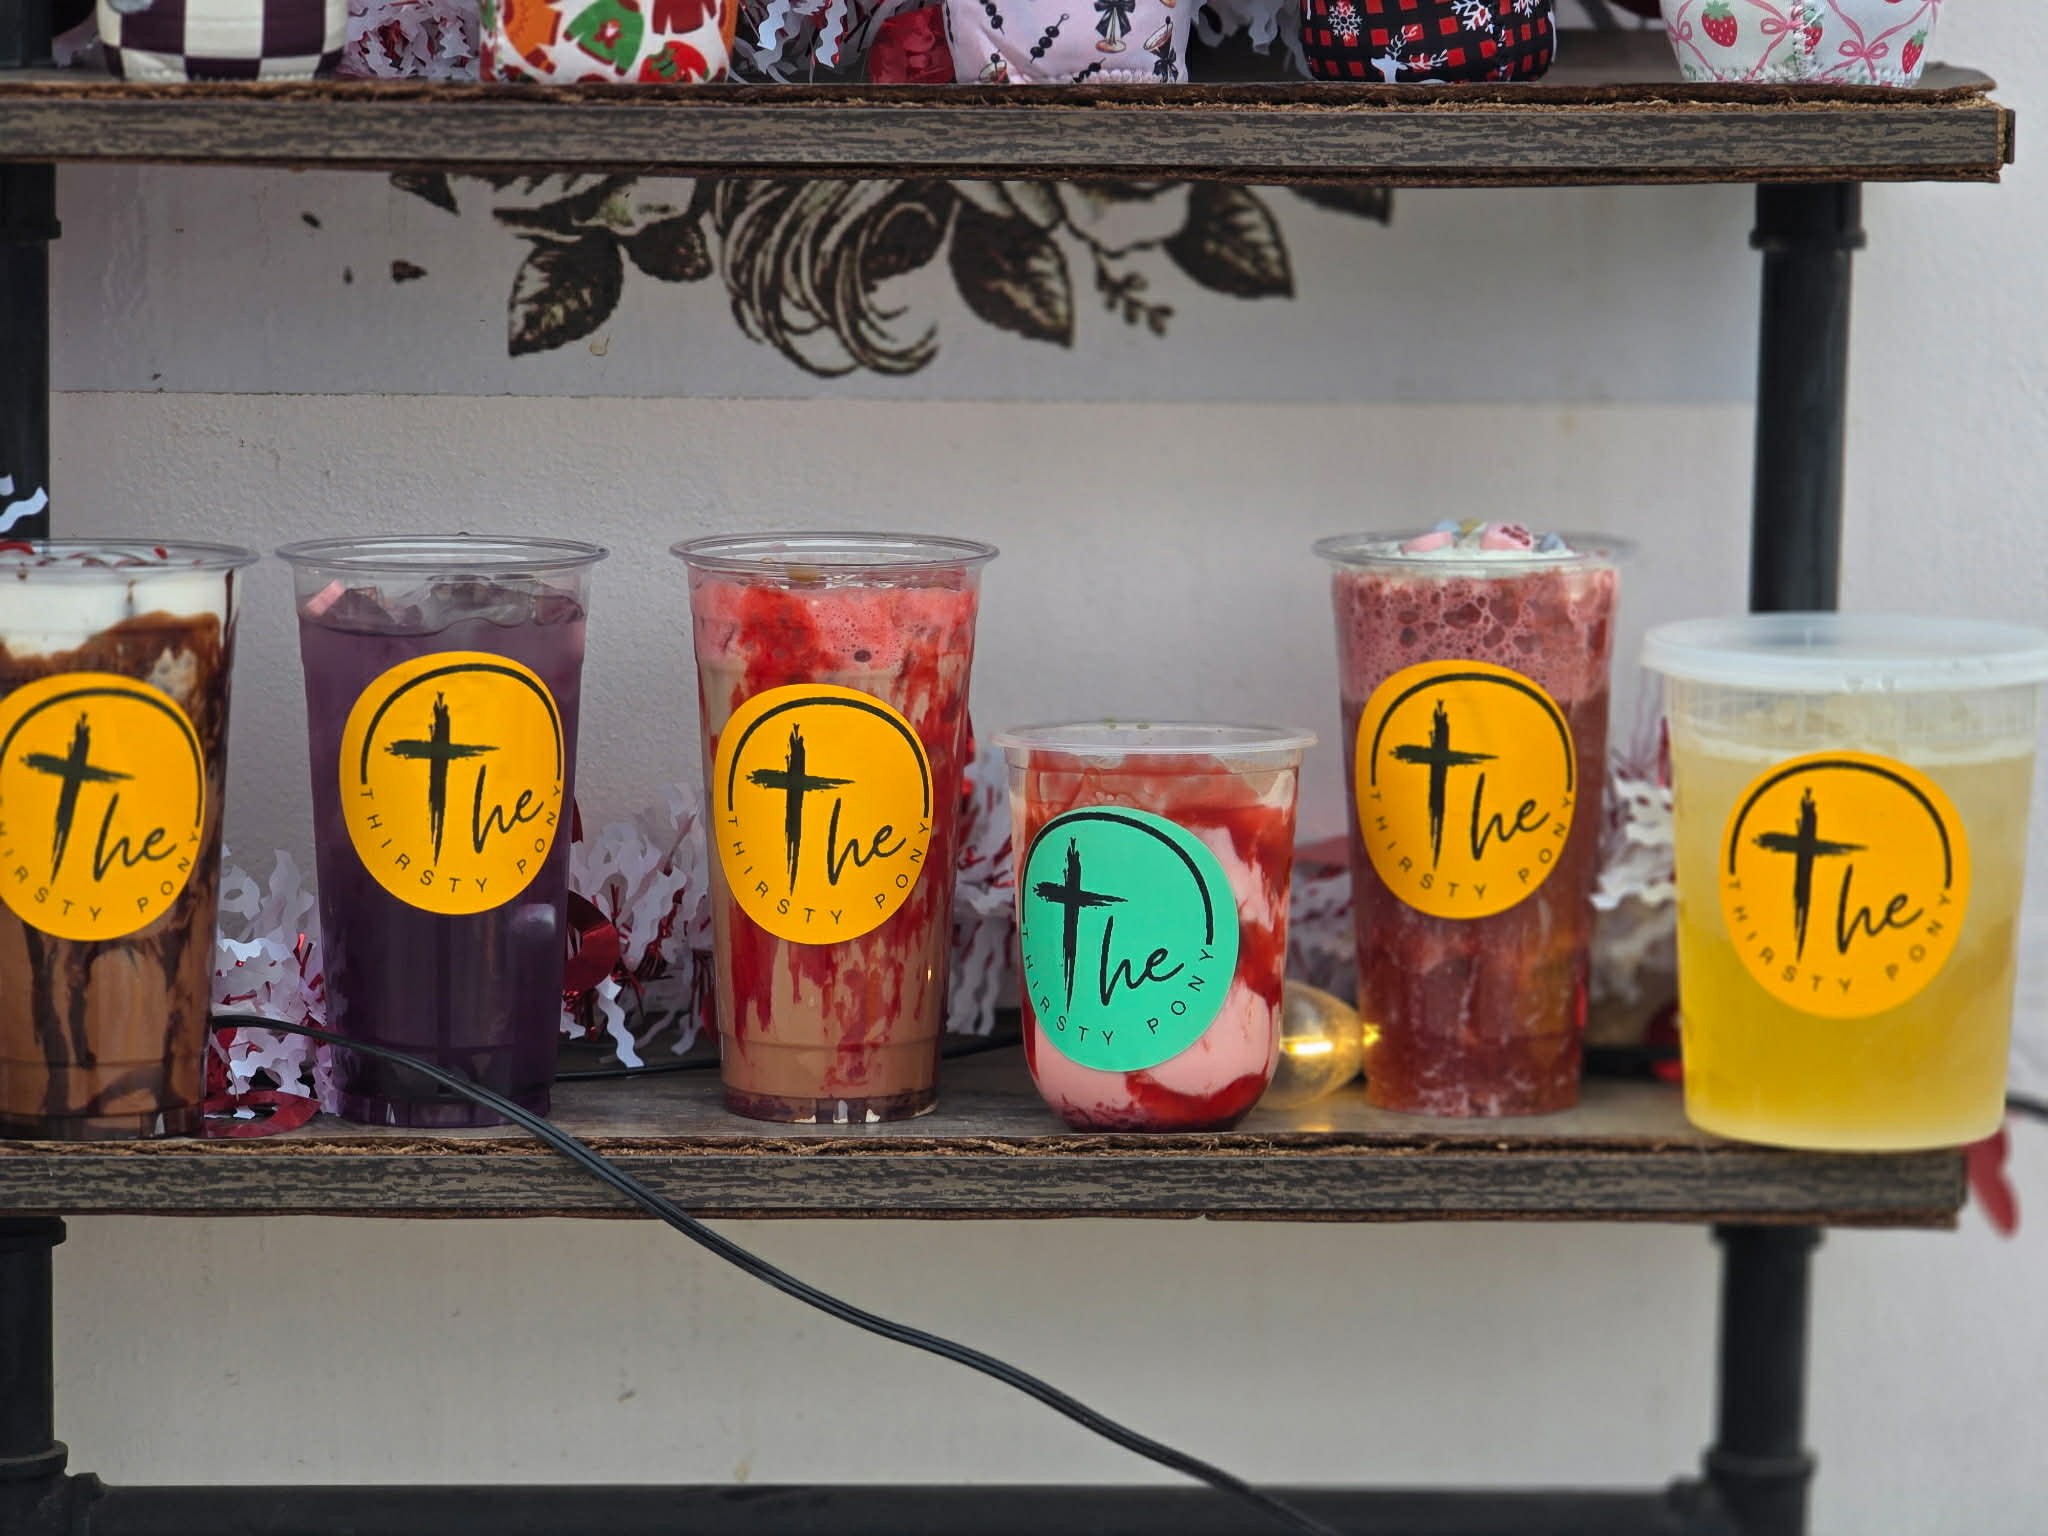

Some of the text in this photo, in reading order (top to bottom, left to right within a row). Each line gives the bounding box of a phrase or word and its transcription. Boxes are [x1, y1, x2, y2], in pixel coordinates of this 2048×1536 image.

[137, 831, 200, 913] PONY
[360, 786, 561, 893] THIRSTY PONY
[728, 815, 929, 924] THIRSTY PONY
[1370, 792, 1572, 898] THIRSTY PONY
[1022, 928, 1214, 1046] THIRSTY PONY
[1728, 881, 1951, 993] THIRSTY PONY
